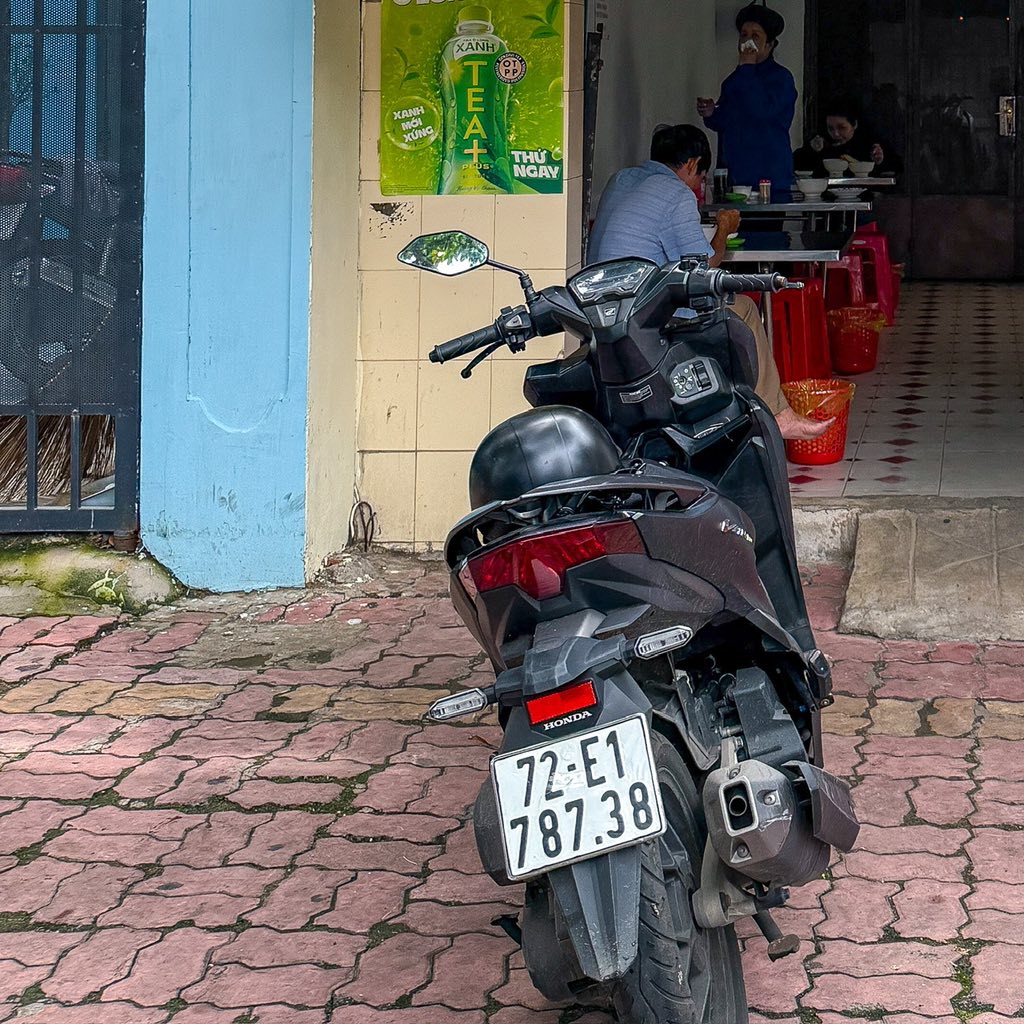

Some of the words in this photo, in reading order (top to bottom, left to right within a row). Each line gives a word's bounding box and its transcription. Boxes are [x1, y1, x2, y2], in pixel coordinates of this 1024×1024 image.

[456, 42, 495, 53] XANH
[393, 106, 425, 120] XANH
[513, 164, 560, 179] NGAY
[543, 711, 592, 731] HONDA
[516, 730, 625, 808] 72-E1
[510, 781, 653, 869] 787.38
